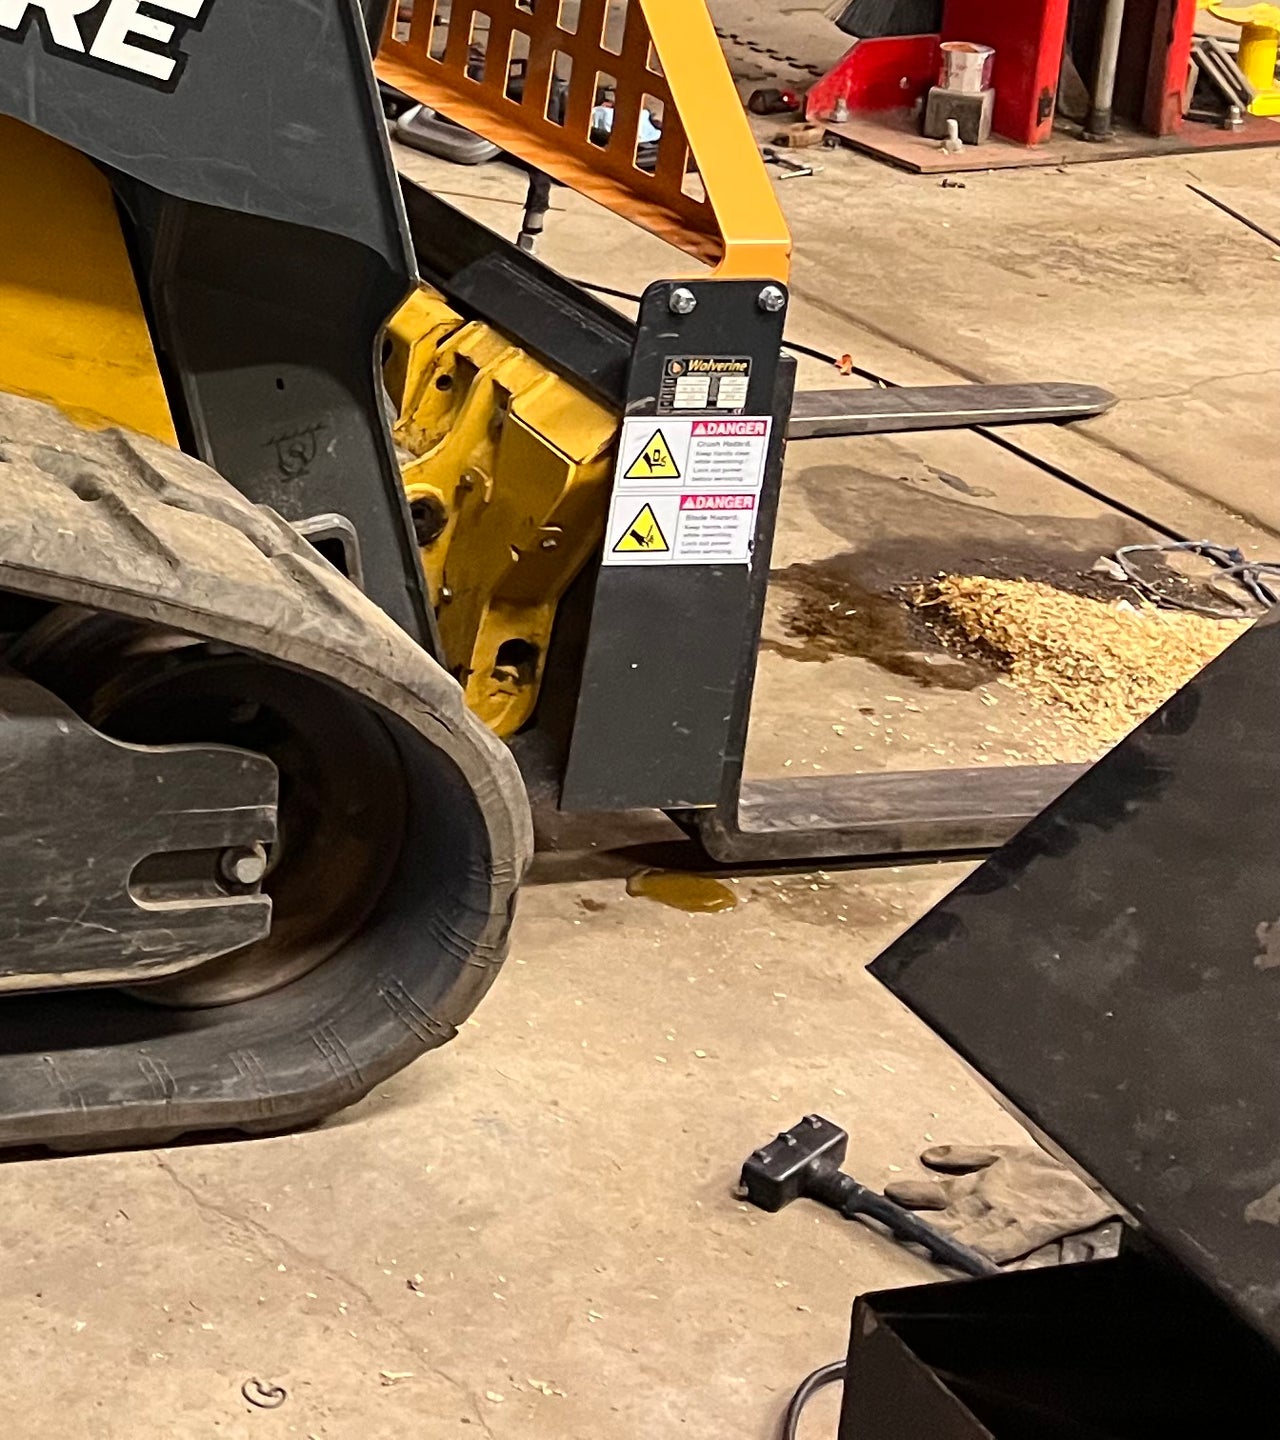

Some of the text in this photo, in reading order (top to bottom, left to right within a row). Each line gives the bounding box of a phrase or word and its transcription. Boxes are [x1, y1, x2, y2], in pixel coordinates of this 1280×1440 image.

[687, 359, 747, 372] Wolverine
[706, 422, 765, 436] DANGER
[696, 496, 753, 509] DANGER
